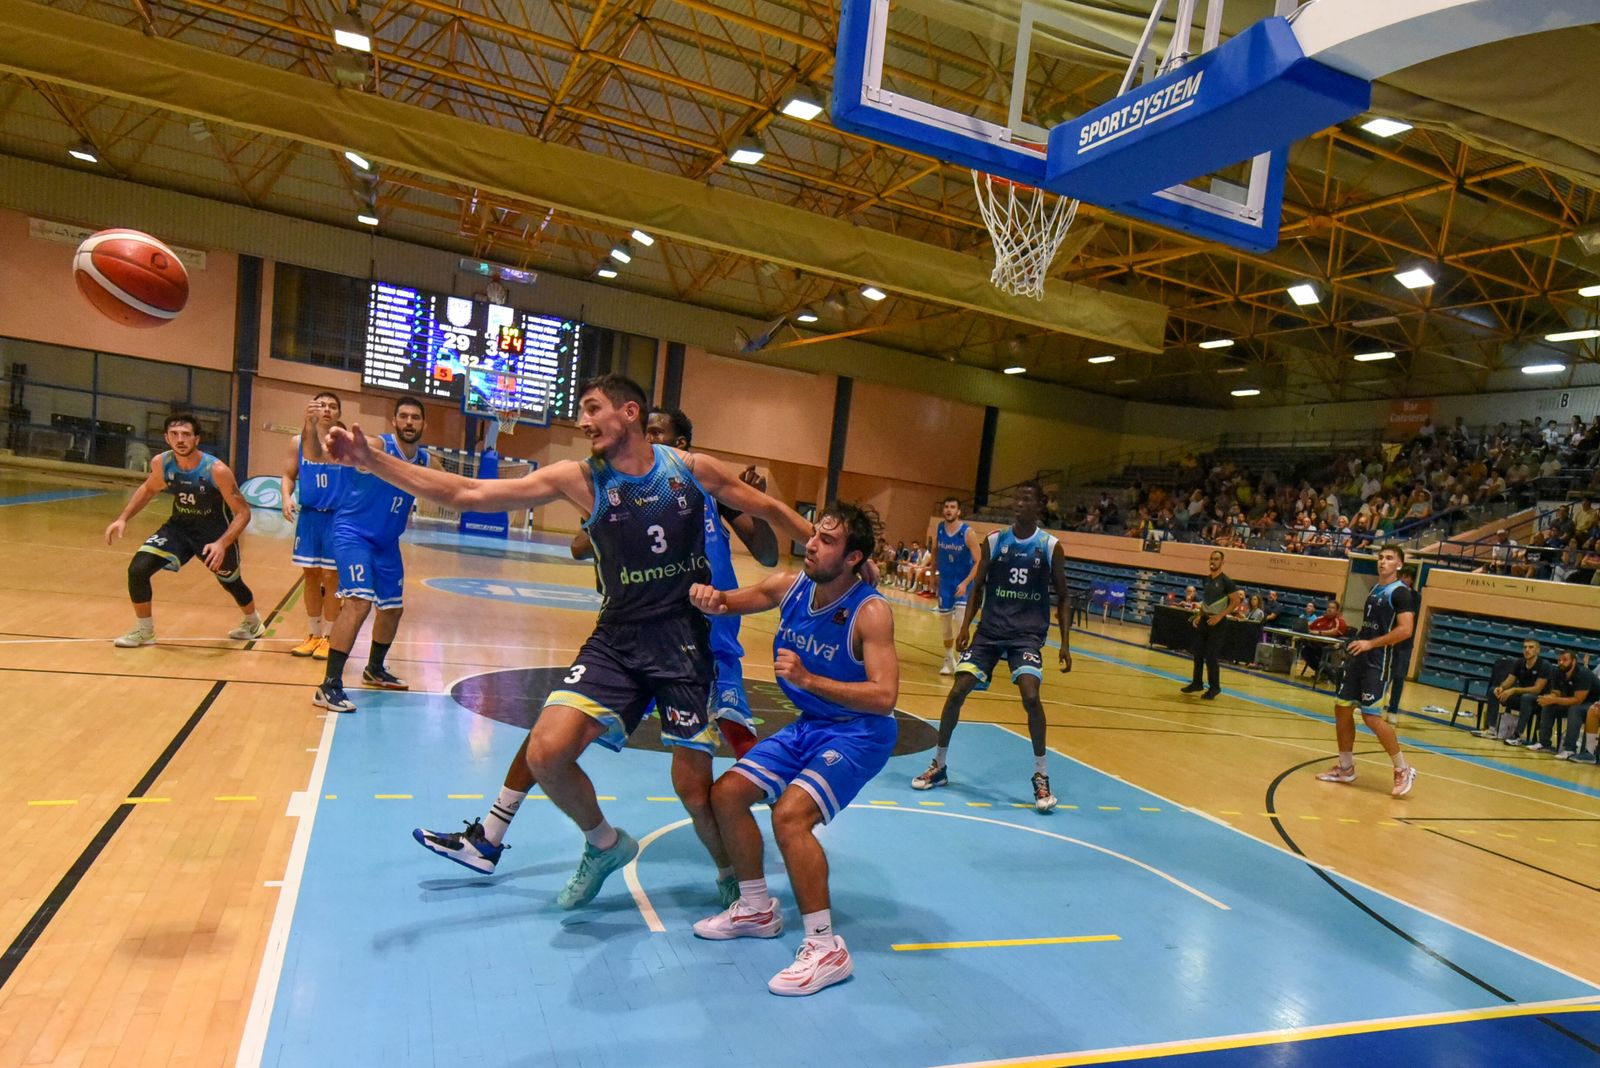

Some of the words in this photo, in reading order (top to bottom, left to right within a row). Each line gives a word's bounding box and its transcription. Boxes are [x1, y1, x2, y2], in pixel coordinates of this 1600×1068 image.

[443, 332, 470, 351] 29
[501, 336, 522, 352] 24
[1560, 393, 1569, 408] B
[315, 473, 328, 488] 10
[179, 492, 196, 505] 24
[390, 496, 403, 514] 12
[145, 534, 168, 546] 24
[647, 524, 668, 554] 3
[348, 564, 365, 582] 12
[620, 552, 711, 585] damex.io
[1009, 567, 1028, 584] 35
[995, 586, 1041, 601] damex.io
[563, 664, 586, 684] 3
